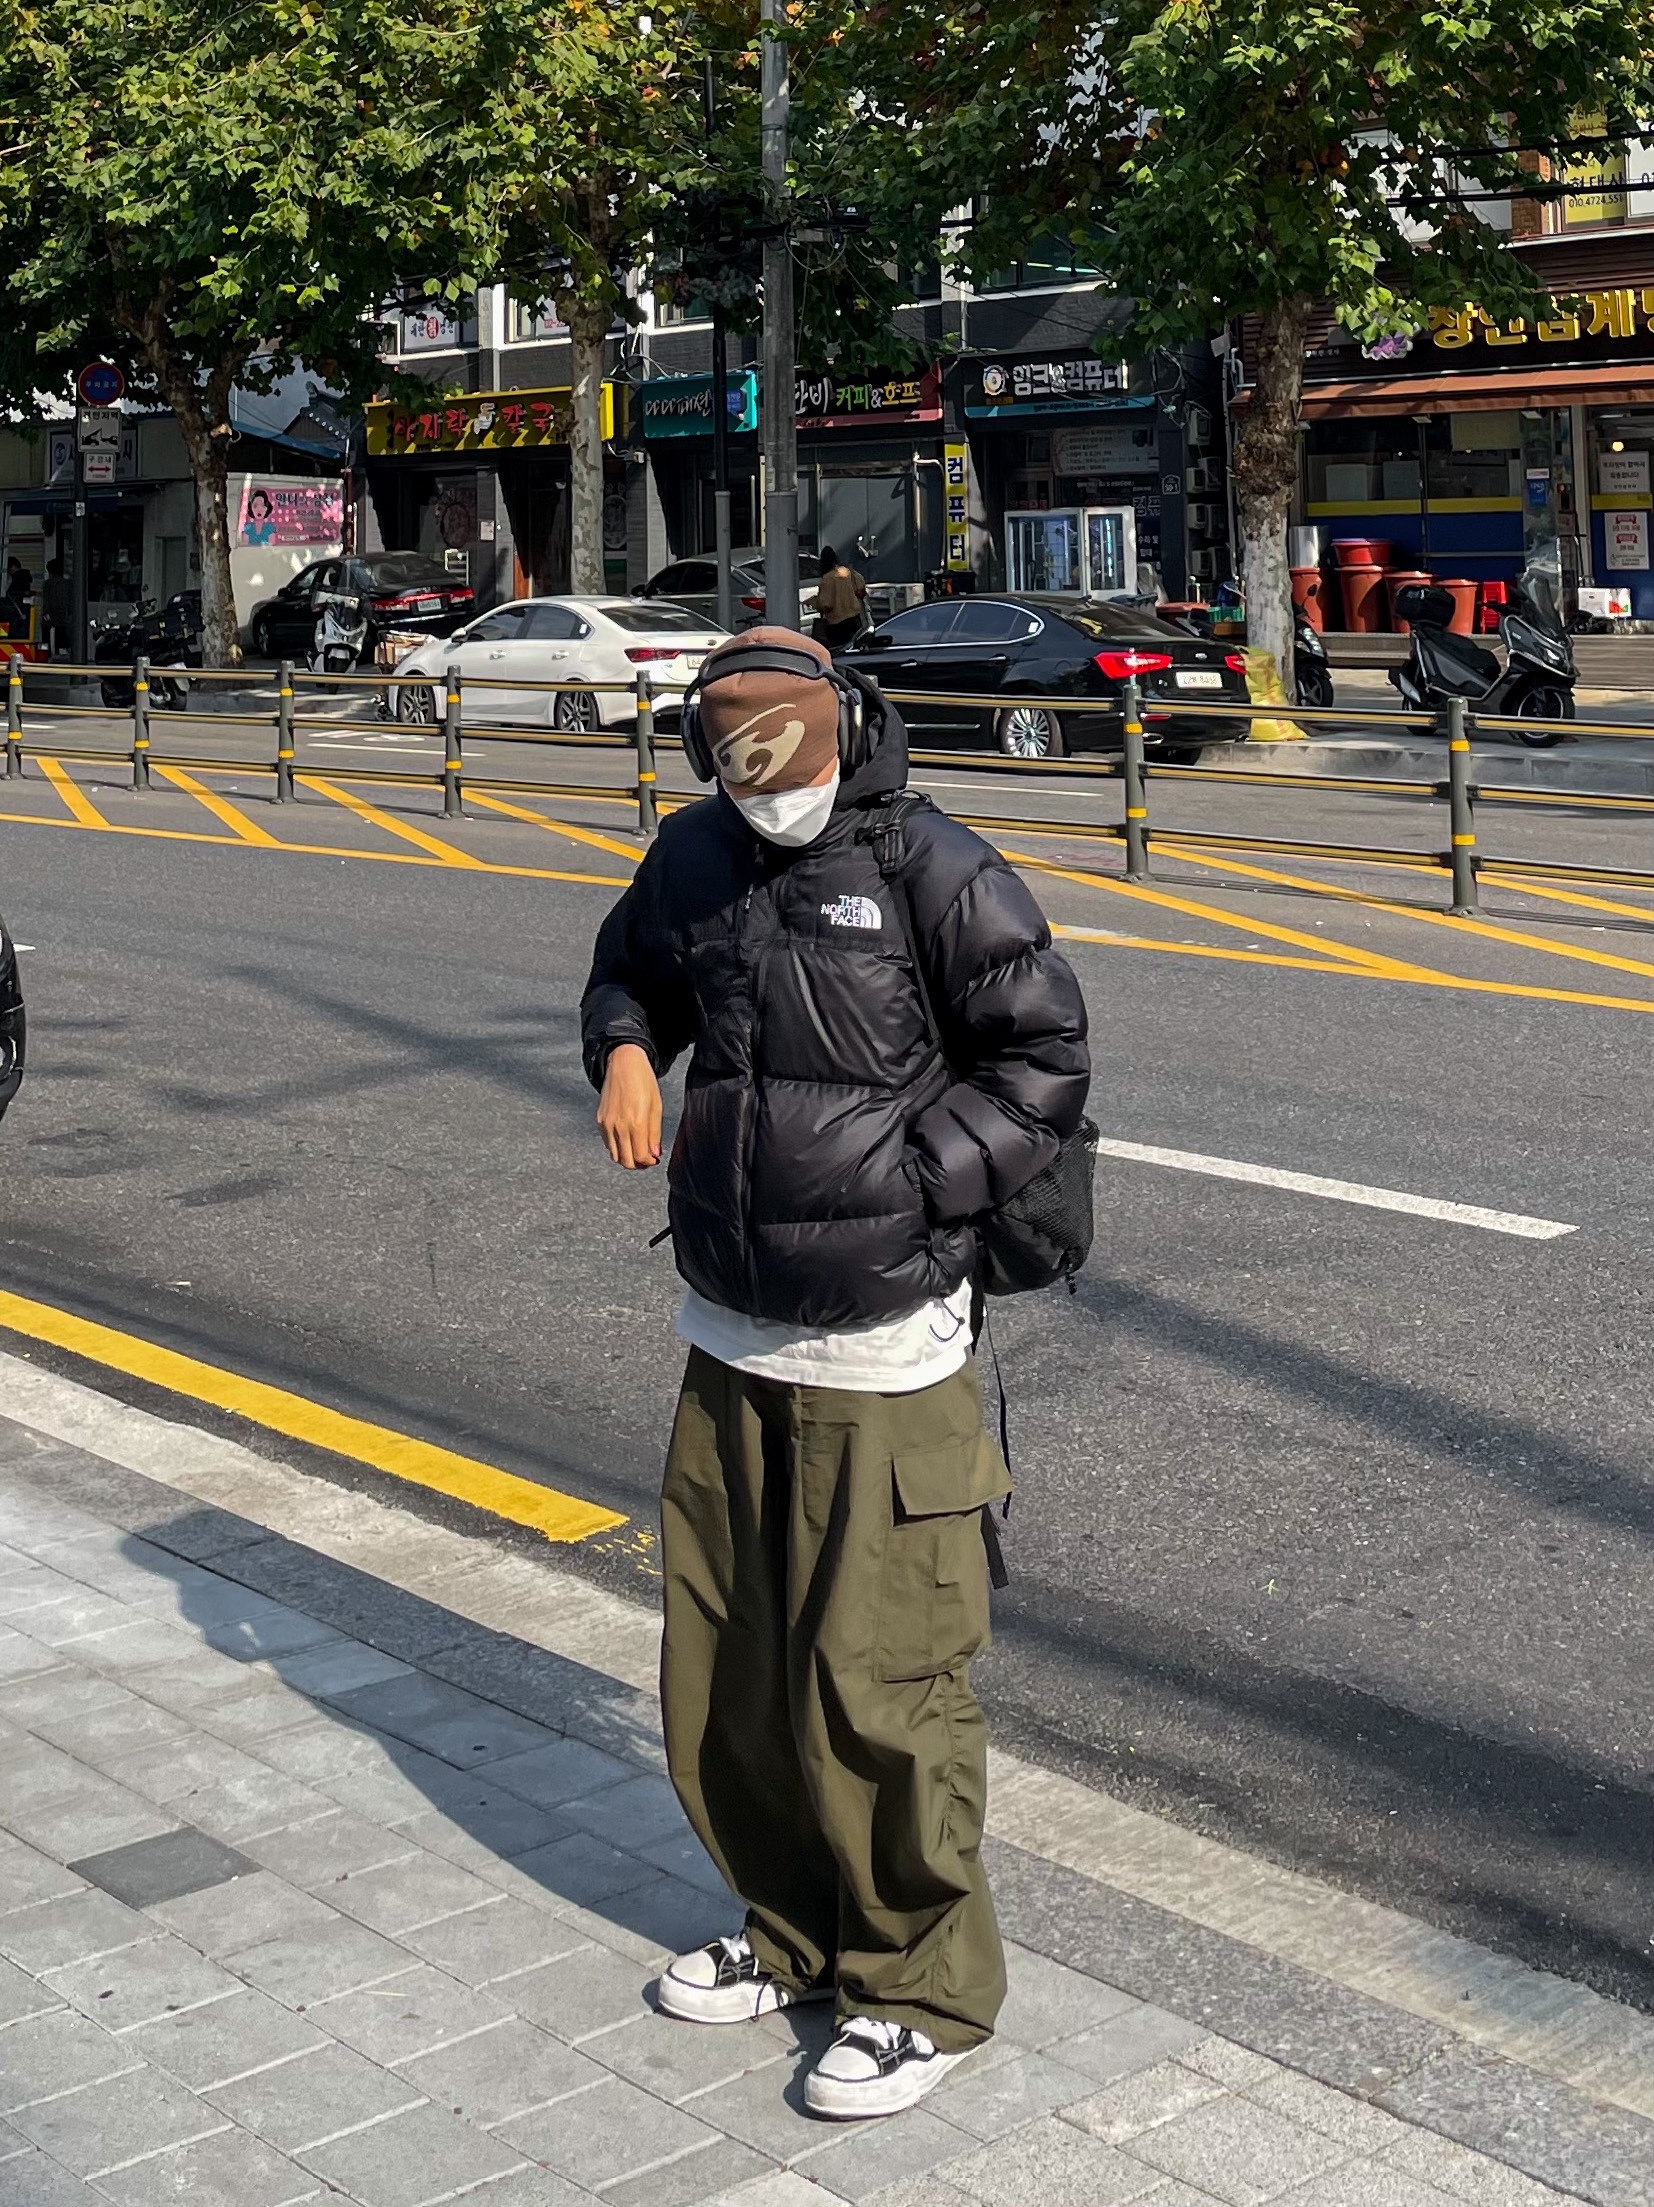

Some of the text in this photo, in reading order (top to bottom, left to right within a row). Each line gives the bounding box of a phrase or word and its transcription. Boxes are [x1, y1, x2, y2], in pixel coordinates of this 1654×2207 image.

[1012, 359, 1129, 397] 잉크&컴퓨터
[836, 381, 922, 411] 커피&호프
[947, 456, 966, 561] 컴퓨터
[821, 904, 861, 917] NORTH
[838, 895, 861, 906] THE
[830, 914, 861, 927] FACE
